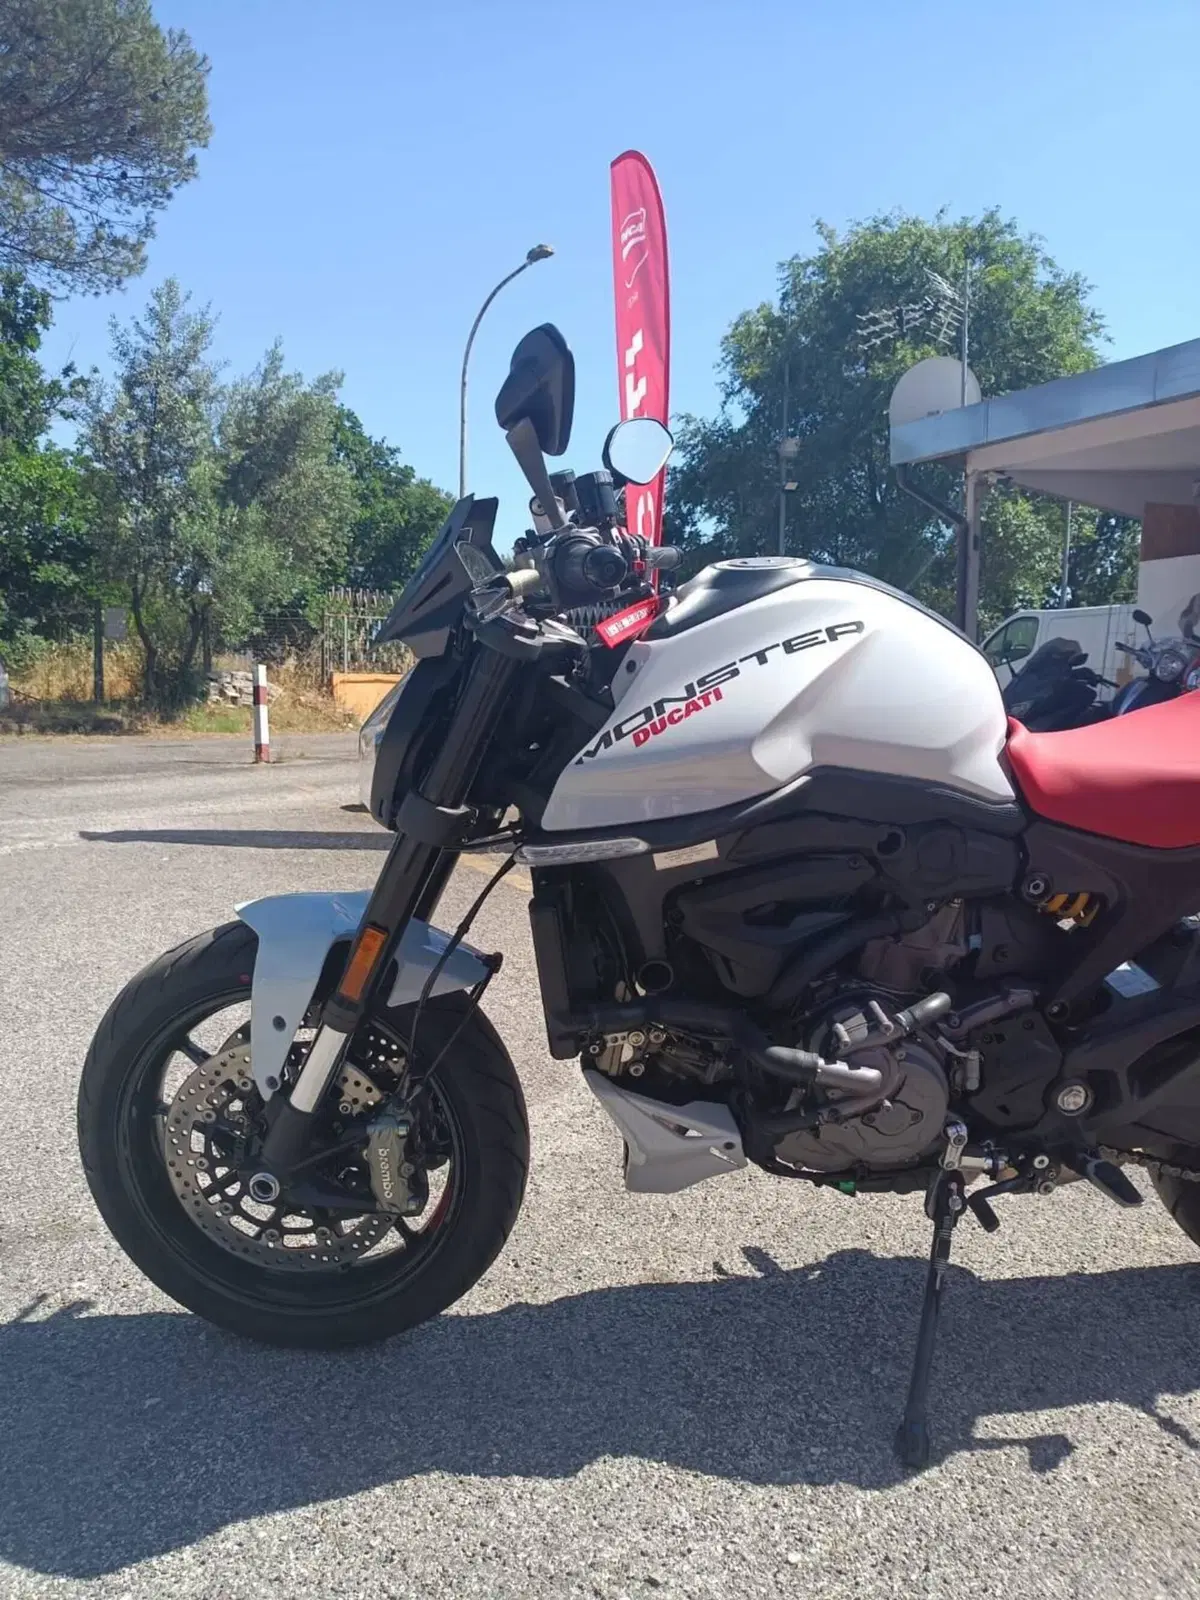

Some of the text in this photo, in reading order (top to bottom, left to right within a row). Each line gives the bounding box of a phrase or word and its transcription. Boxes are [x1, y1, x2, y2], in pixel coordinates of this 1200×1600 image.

[575, 620, 866, 765] MONSTER
[631, 686, 723, 748] DUCATI
[378, 1148, 393, 1199] brembo
